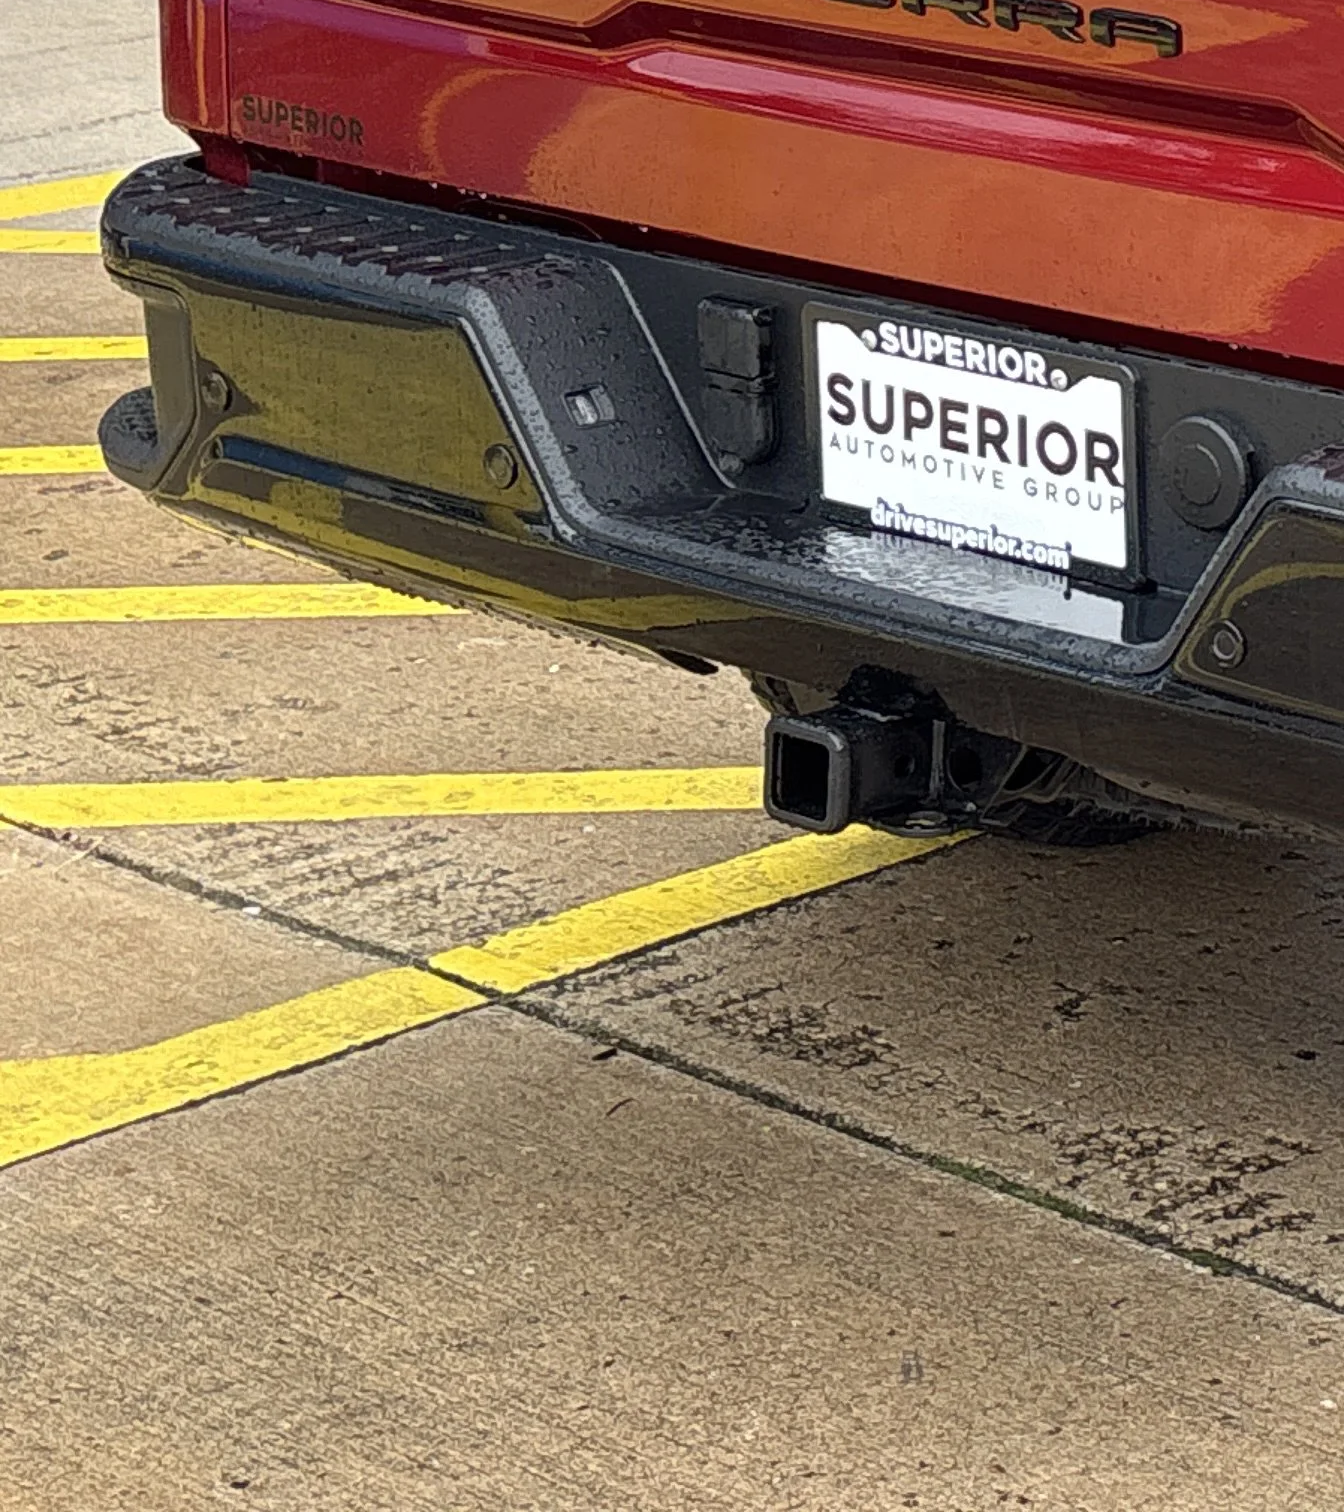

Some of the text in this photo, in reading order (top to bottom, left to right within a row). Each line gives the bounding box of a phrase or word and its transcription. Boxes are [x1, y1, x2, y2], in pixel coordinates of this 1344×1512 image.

[242, 94, 364, 146] SUPERIOR
[877, 321, 1049, 388] SUPERIOR
[826, 372, 1126, 489] SUPERIOR
[828, 432, 1126, 515] AUTOMOTIVE GROUP
[870, 501, 1071, 570] drivesuperior.com
